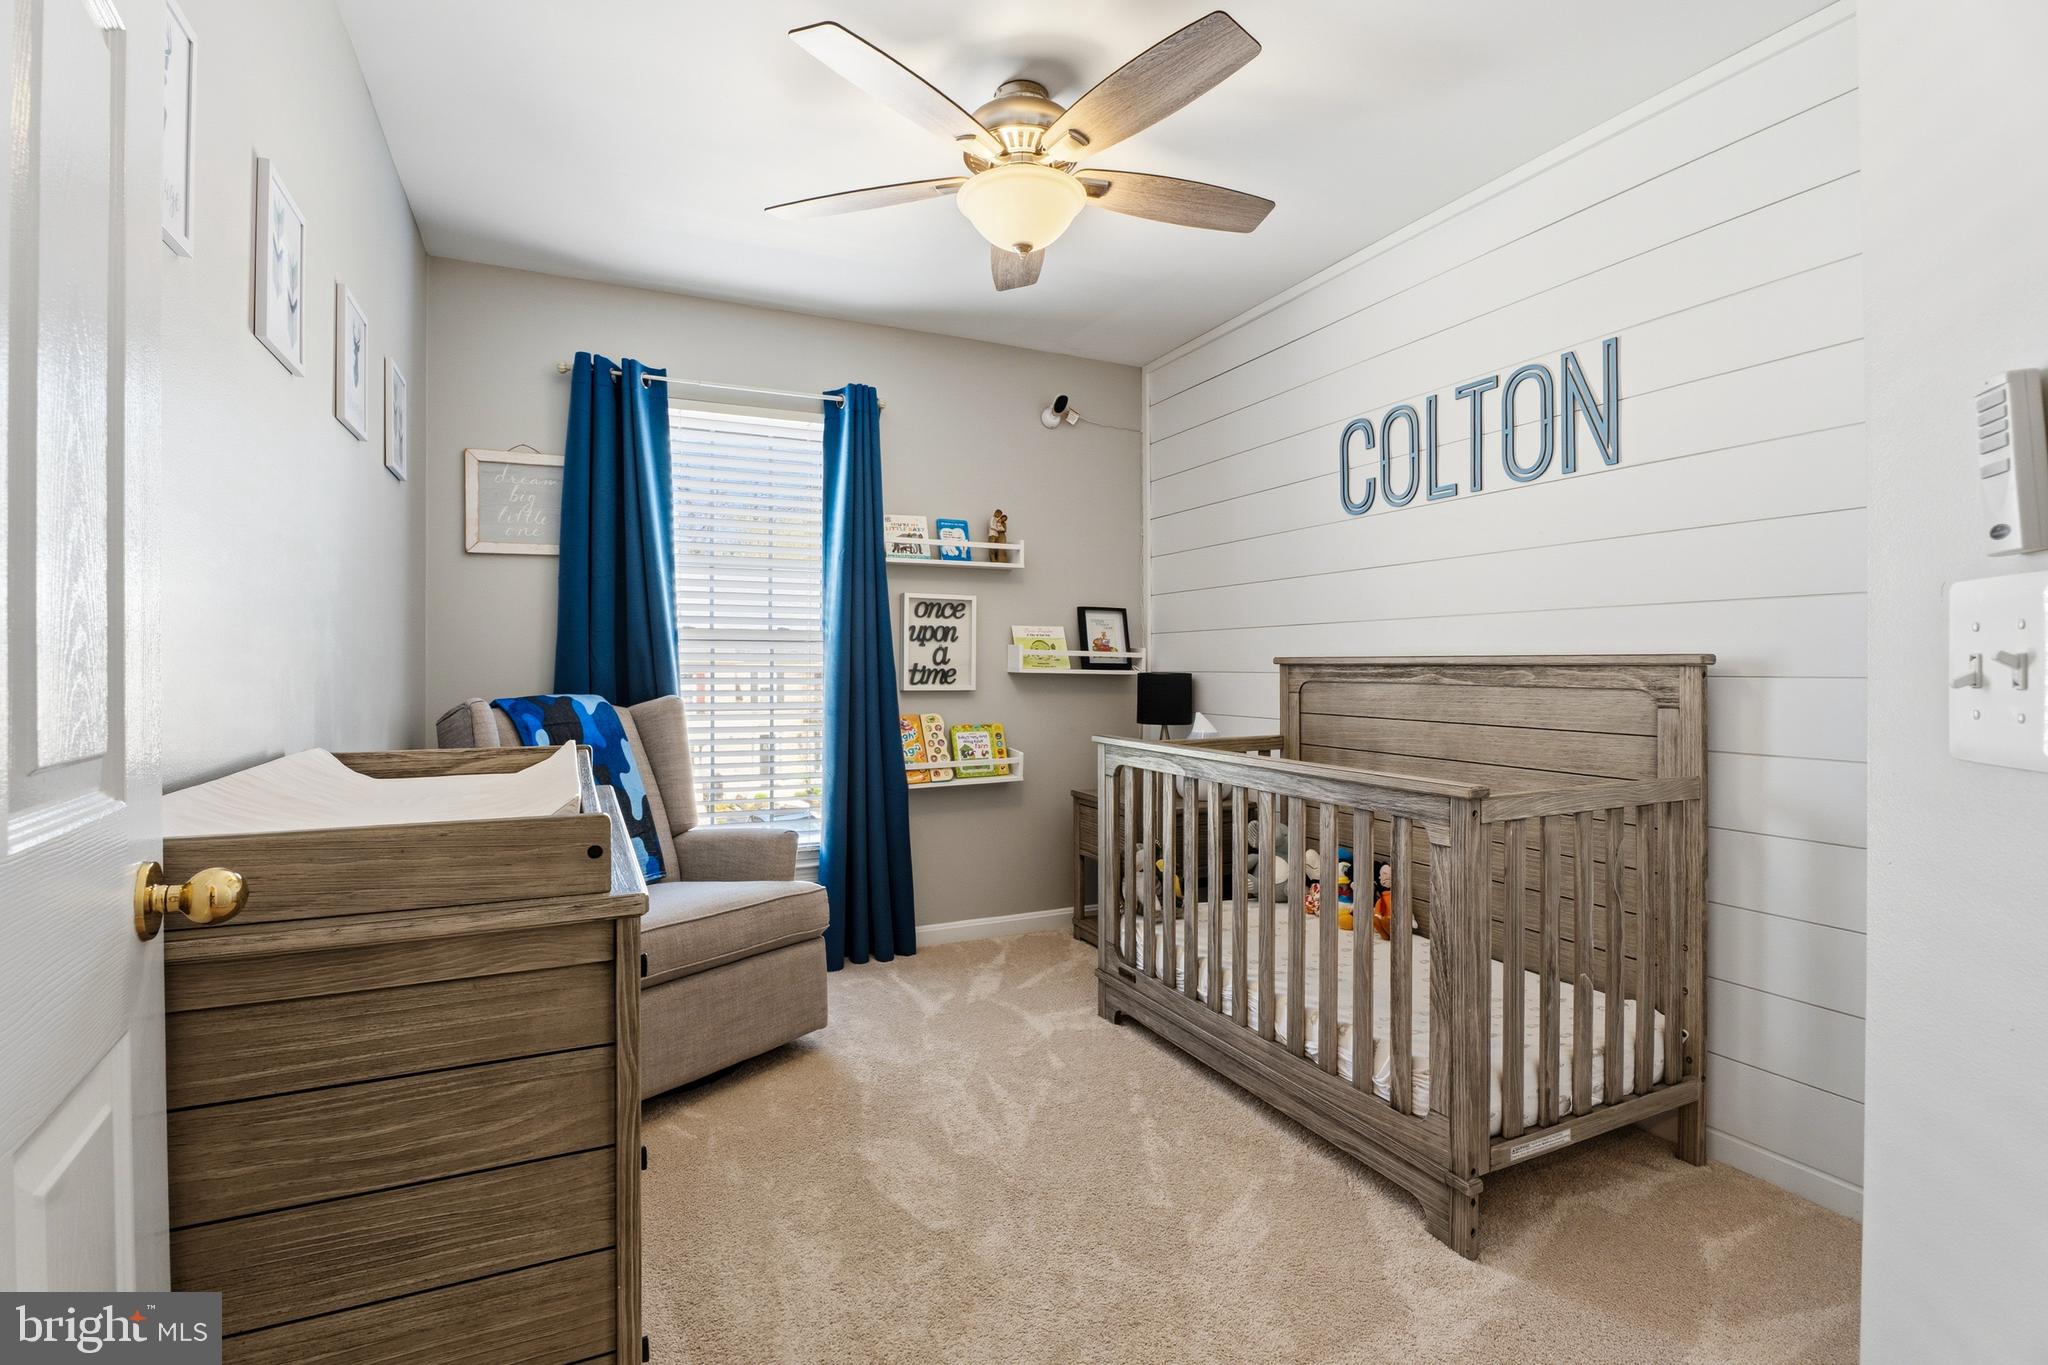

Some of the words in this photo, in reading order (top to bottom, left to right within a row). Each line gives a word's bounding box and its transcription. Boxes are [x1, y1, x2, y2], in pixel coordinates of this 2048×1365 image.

[1339, 337, 1619, 515] COLTON
[510, 485, 536, 513] big
[505, 527, 544, 537] one
[914, 601, 966, 619] once
[908, 625, 959, 647] upon
[932, 646, 951, 666] a
[908, 662, 957, 686] time
